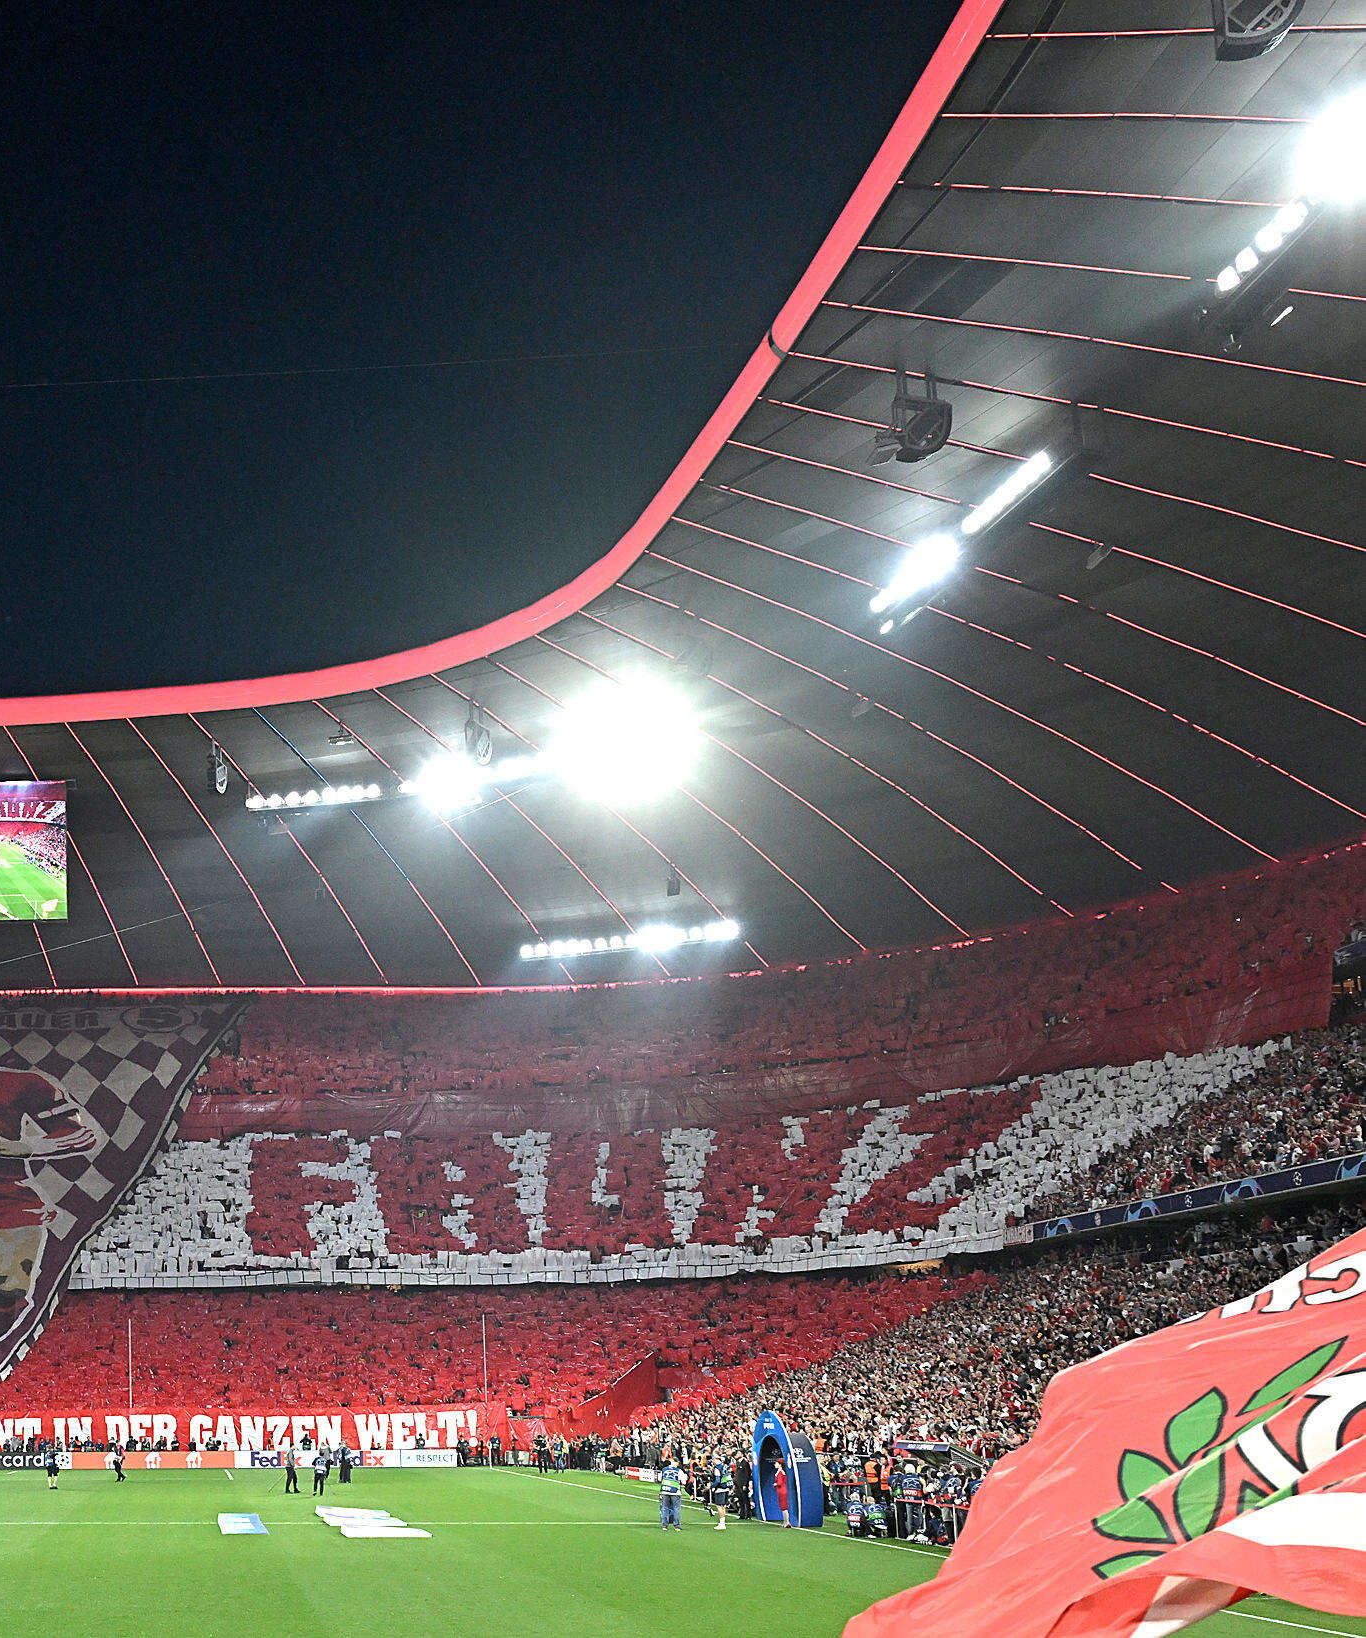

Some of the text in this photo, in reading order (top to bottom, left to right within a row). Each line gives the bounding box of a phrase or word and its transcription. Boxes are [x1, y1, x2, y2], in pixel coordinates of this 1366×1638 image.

[53, 1416, 93, 1451] IN
[105, 1413, 178, 1451] DER
[189, 1414, 342, 1451] GANZEN
[354, 1409, 478, 1450] WELT!
[416, 1453, 453, 1463] RESPECT
